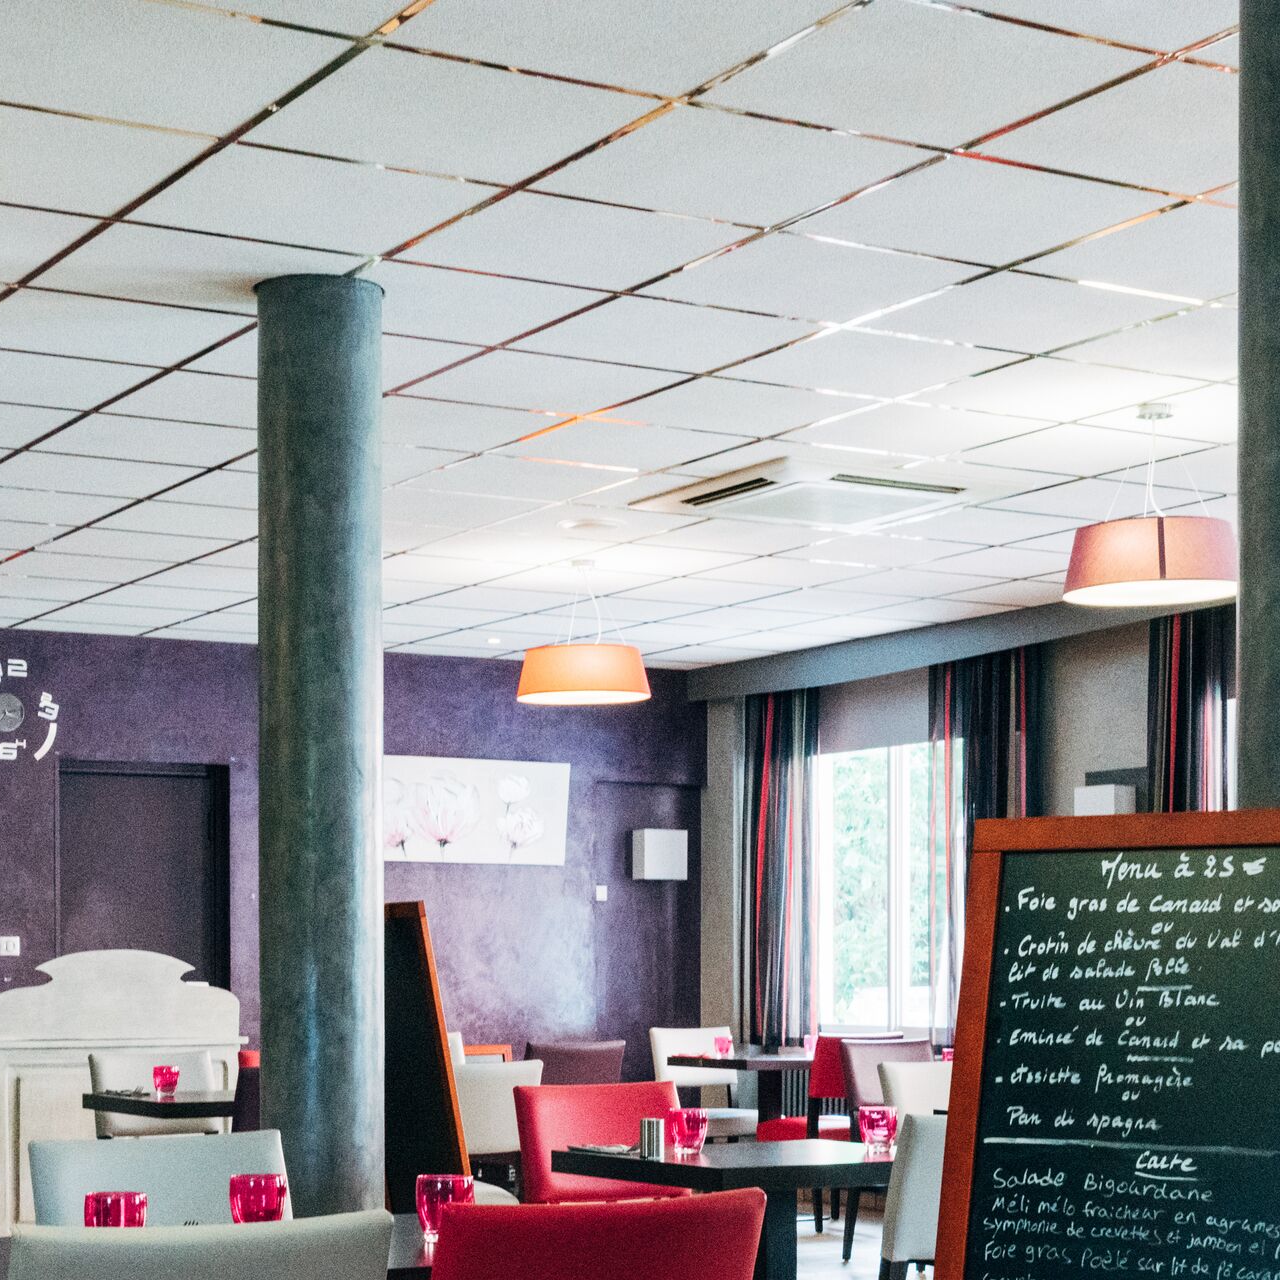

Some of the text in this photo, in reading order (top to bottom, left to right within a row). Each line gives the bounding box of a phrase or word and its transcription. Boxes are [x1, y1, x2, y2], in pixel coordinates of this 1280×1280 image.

[1101, 852, 1162, 889] Menu
[1174, 852, 1195, 878] à
[1017, 886, 1057, 911] Foie
[1066, 897, 1108, 921] gras
[1116, 891, 1141, 913] de
[1149, 893, 1222, 913] Canard
[1233, 894, 1255, 914] et
[1151, 921, 1175, 936] ou
[1077, 931, 1097, 956] de
[1104, 928, 1162, 953] chèvre
[1175, 930, 1198, 950] du
[1207, 928, 1242, 949] Val
[1008, 961, 1037, 983] lit
[1041, 961, 1060, 982] de
[1069, 957, 1136, 979] salade
[1011, 988, 1221, 1012] Truite au Vin Blanc
[1125, 1015, 1147, 1028] ou
[1008, 1025, 1079, 1047] Emincé
[1085, 1028, 1104, 1047] de
[1191, 1033, 1211, 1050] et
[1219, 1035, 1250, 1052] sa
[1121, 1089, 1142, 1102] ou
[1006, 1105, 1042, 1126] Pan
[1054, 1108, 1075, 1128] di
[1135, 1150, 1198, 1173] Carte
[992, 1167, 1067, 1190] Salade
[1082, 1172, 1213, 1202] Bigourdane
[991, 1193, 1031, 1214] Méli
[1037, 1195, 1076, 1218] mélo
[1174, 1212, 1198, 1226] en
[1066, 1221, 1086, 1239] de
[984, 1240, 1017, 1261] Foie
[1025, 1245, 1073, 1265] gras
[1138, 1257, 1167, 1274] sur
[1191, 1257, 1210, 1275] de
